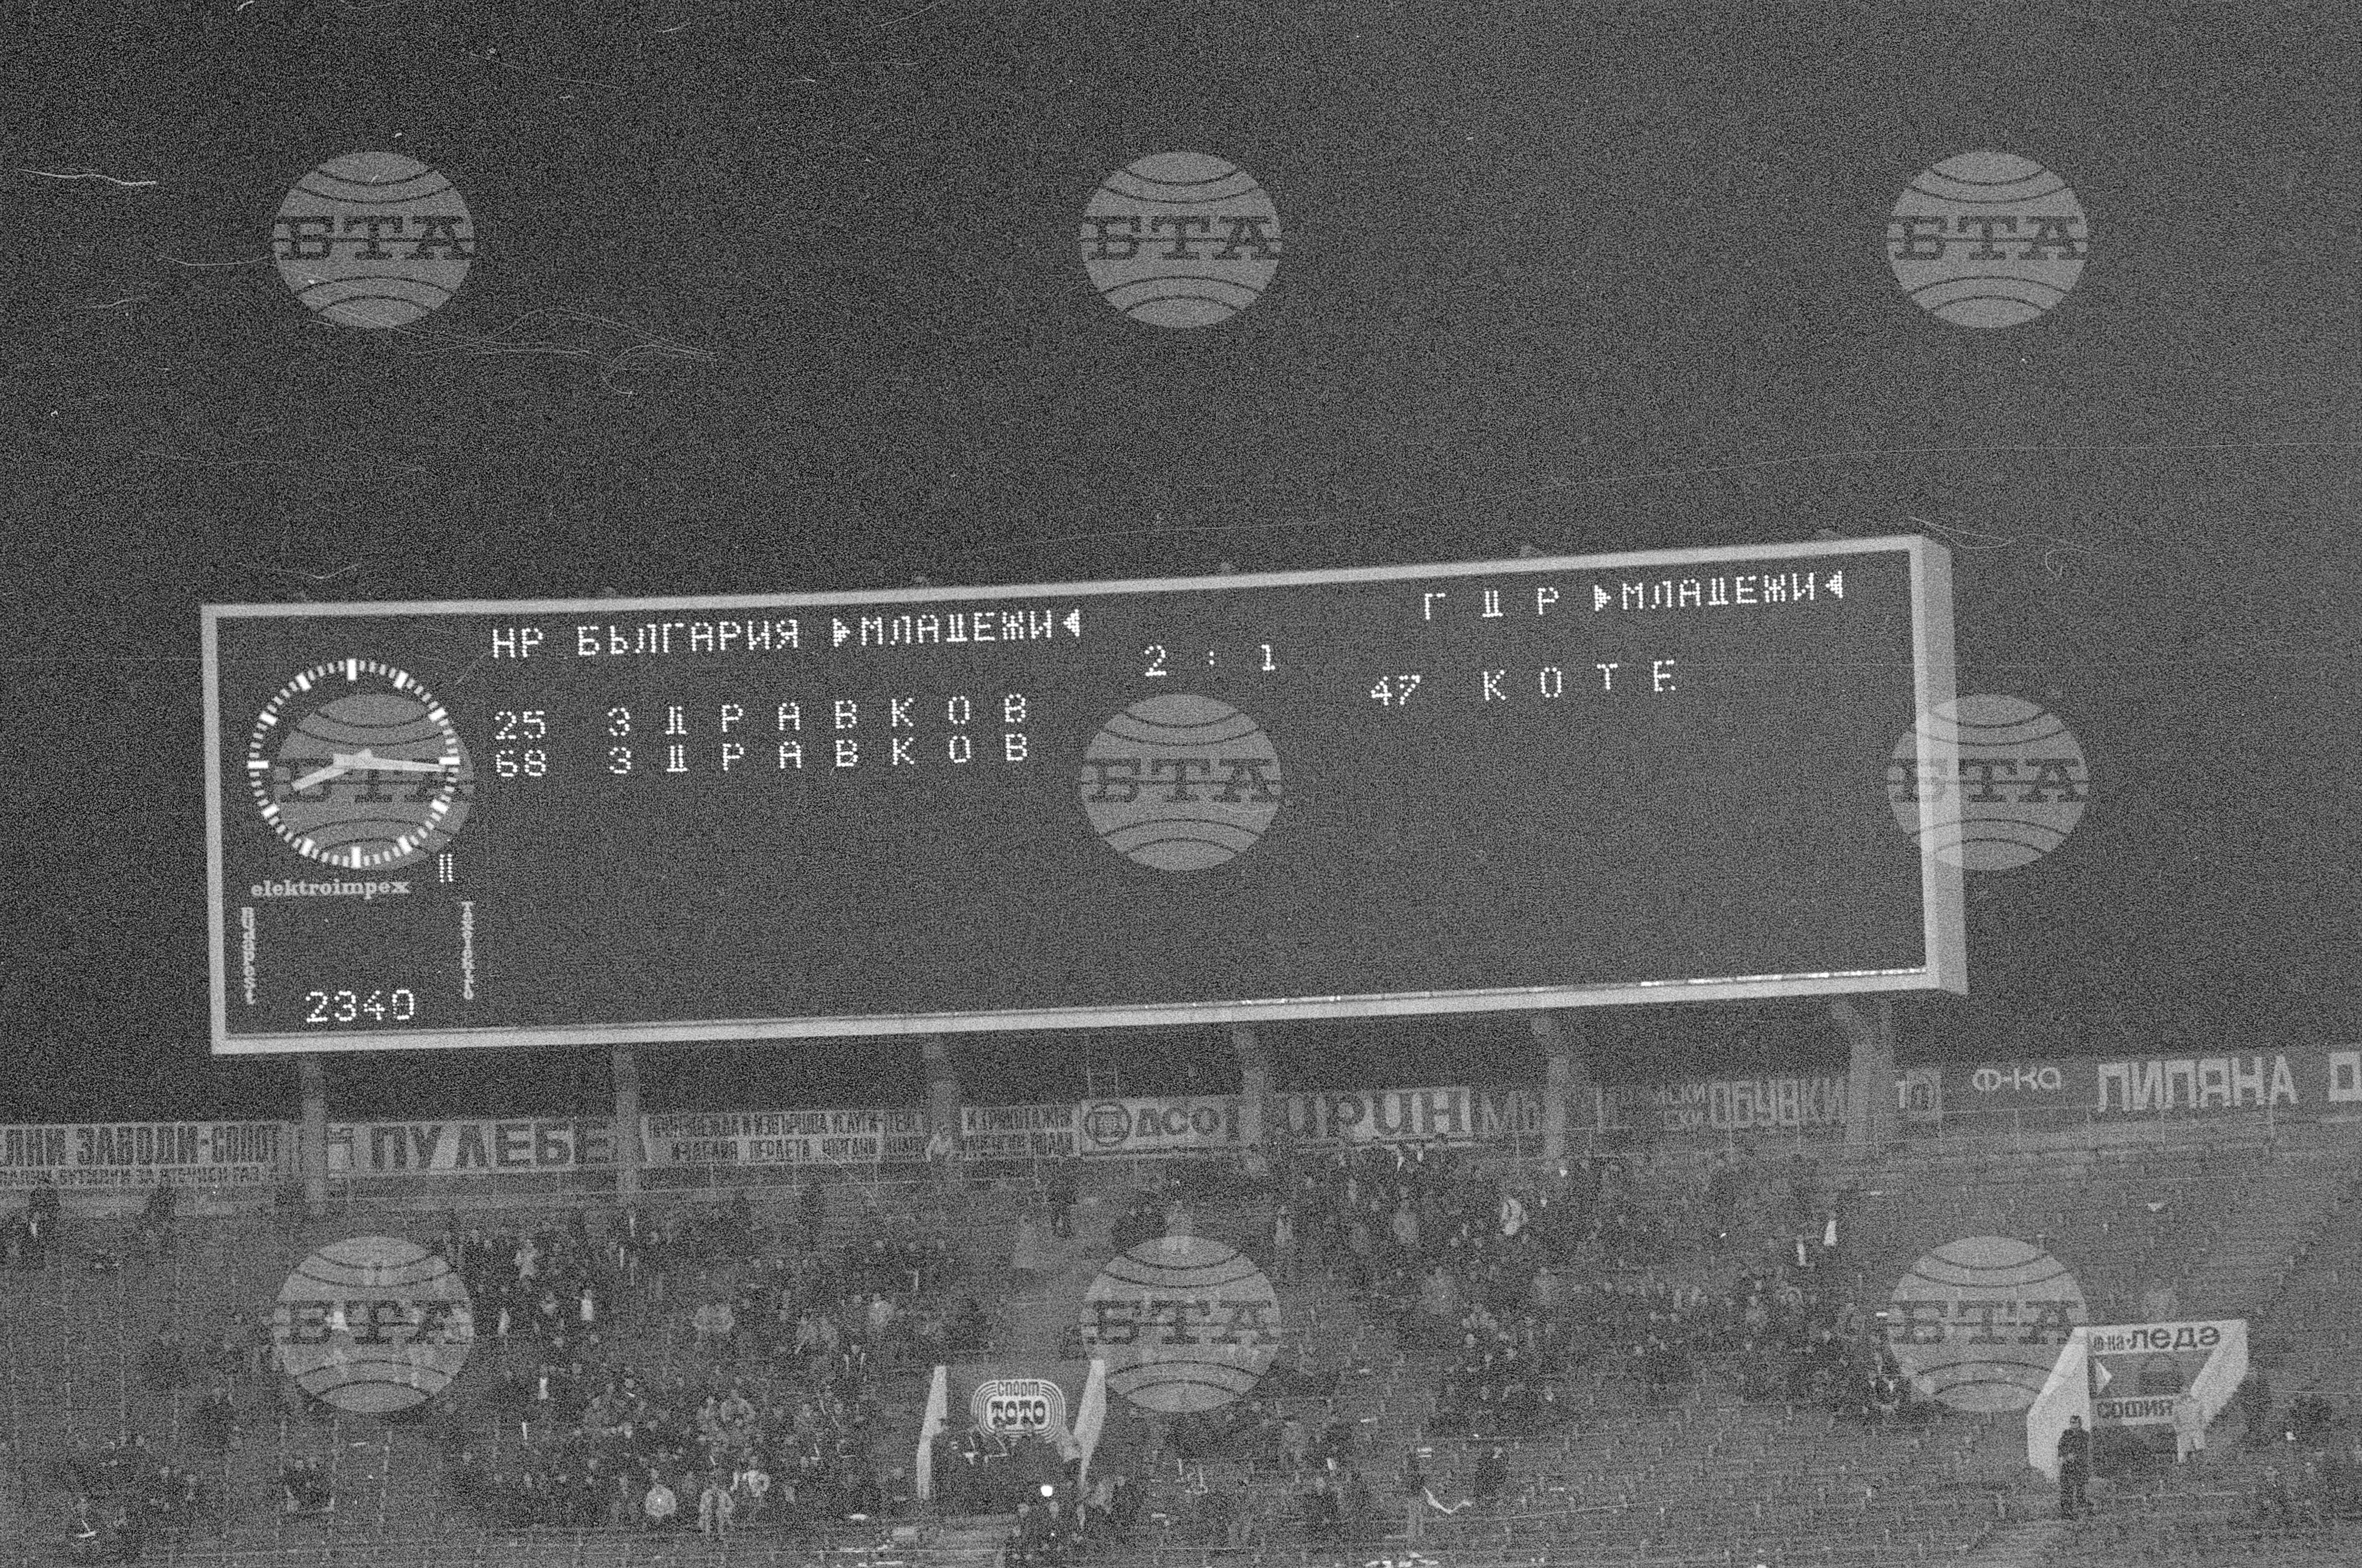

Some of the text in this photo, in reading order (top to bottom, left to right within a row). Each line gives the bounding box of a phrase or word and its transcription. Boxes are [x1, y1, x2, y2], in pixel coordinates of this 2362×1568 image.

[1622, 572, 1814, 609] МЛАДЕЖИ
[493, 610, 1052, 658] НР БЪЛГАРИЯ МЛАДЕЖИ
[1371, 675, 1420, 705] 47
[495, 711, 545, 740] 25
[496, 750, 546, 778] 68
[252, 878, 410, 900] elektroimpex
[306, 989, 415, 1023] 2340
